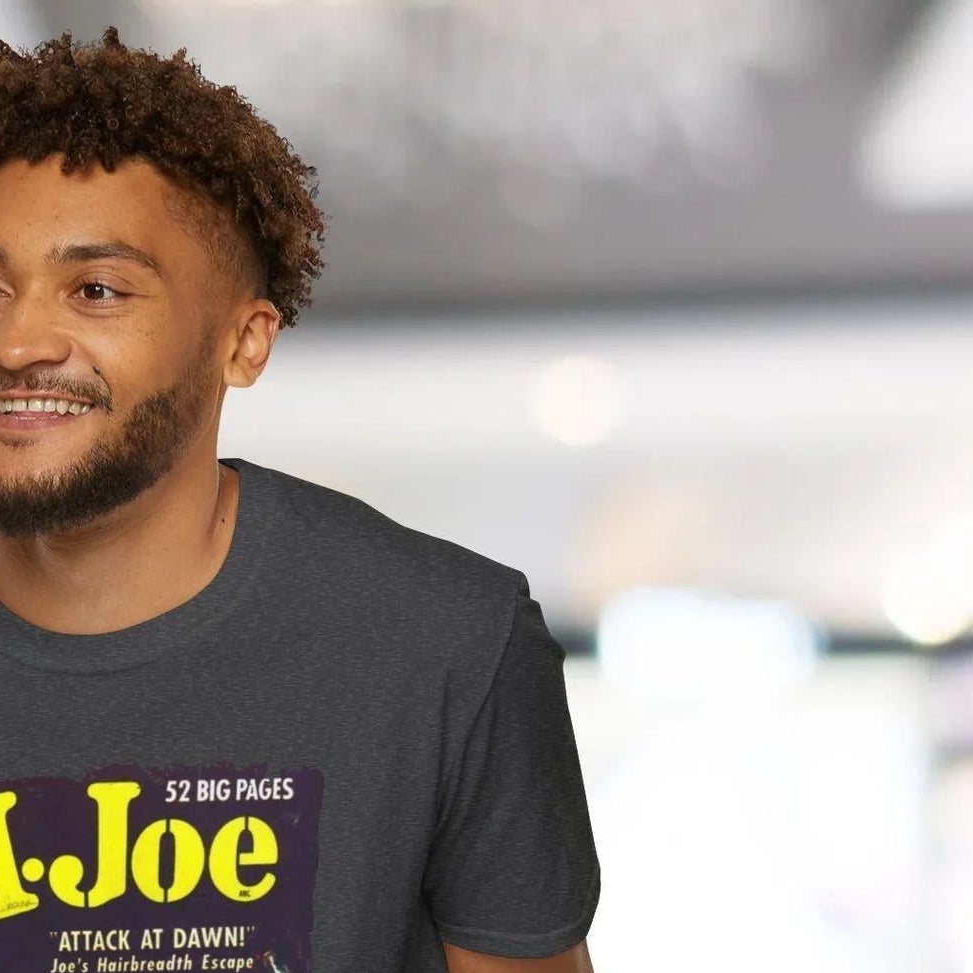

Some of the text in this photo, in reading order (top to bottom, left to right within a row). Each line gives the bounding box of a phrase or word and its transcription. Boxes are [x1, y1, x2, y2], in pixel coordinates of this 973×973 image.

[165, 777, 295, 804] 52 BIG PAGES
[140, 928, 163, 950] AT
[50, 954, 254, 973] Joe's Hairbreadth Escape
